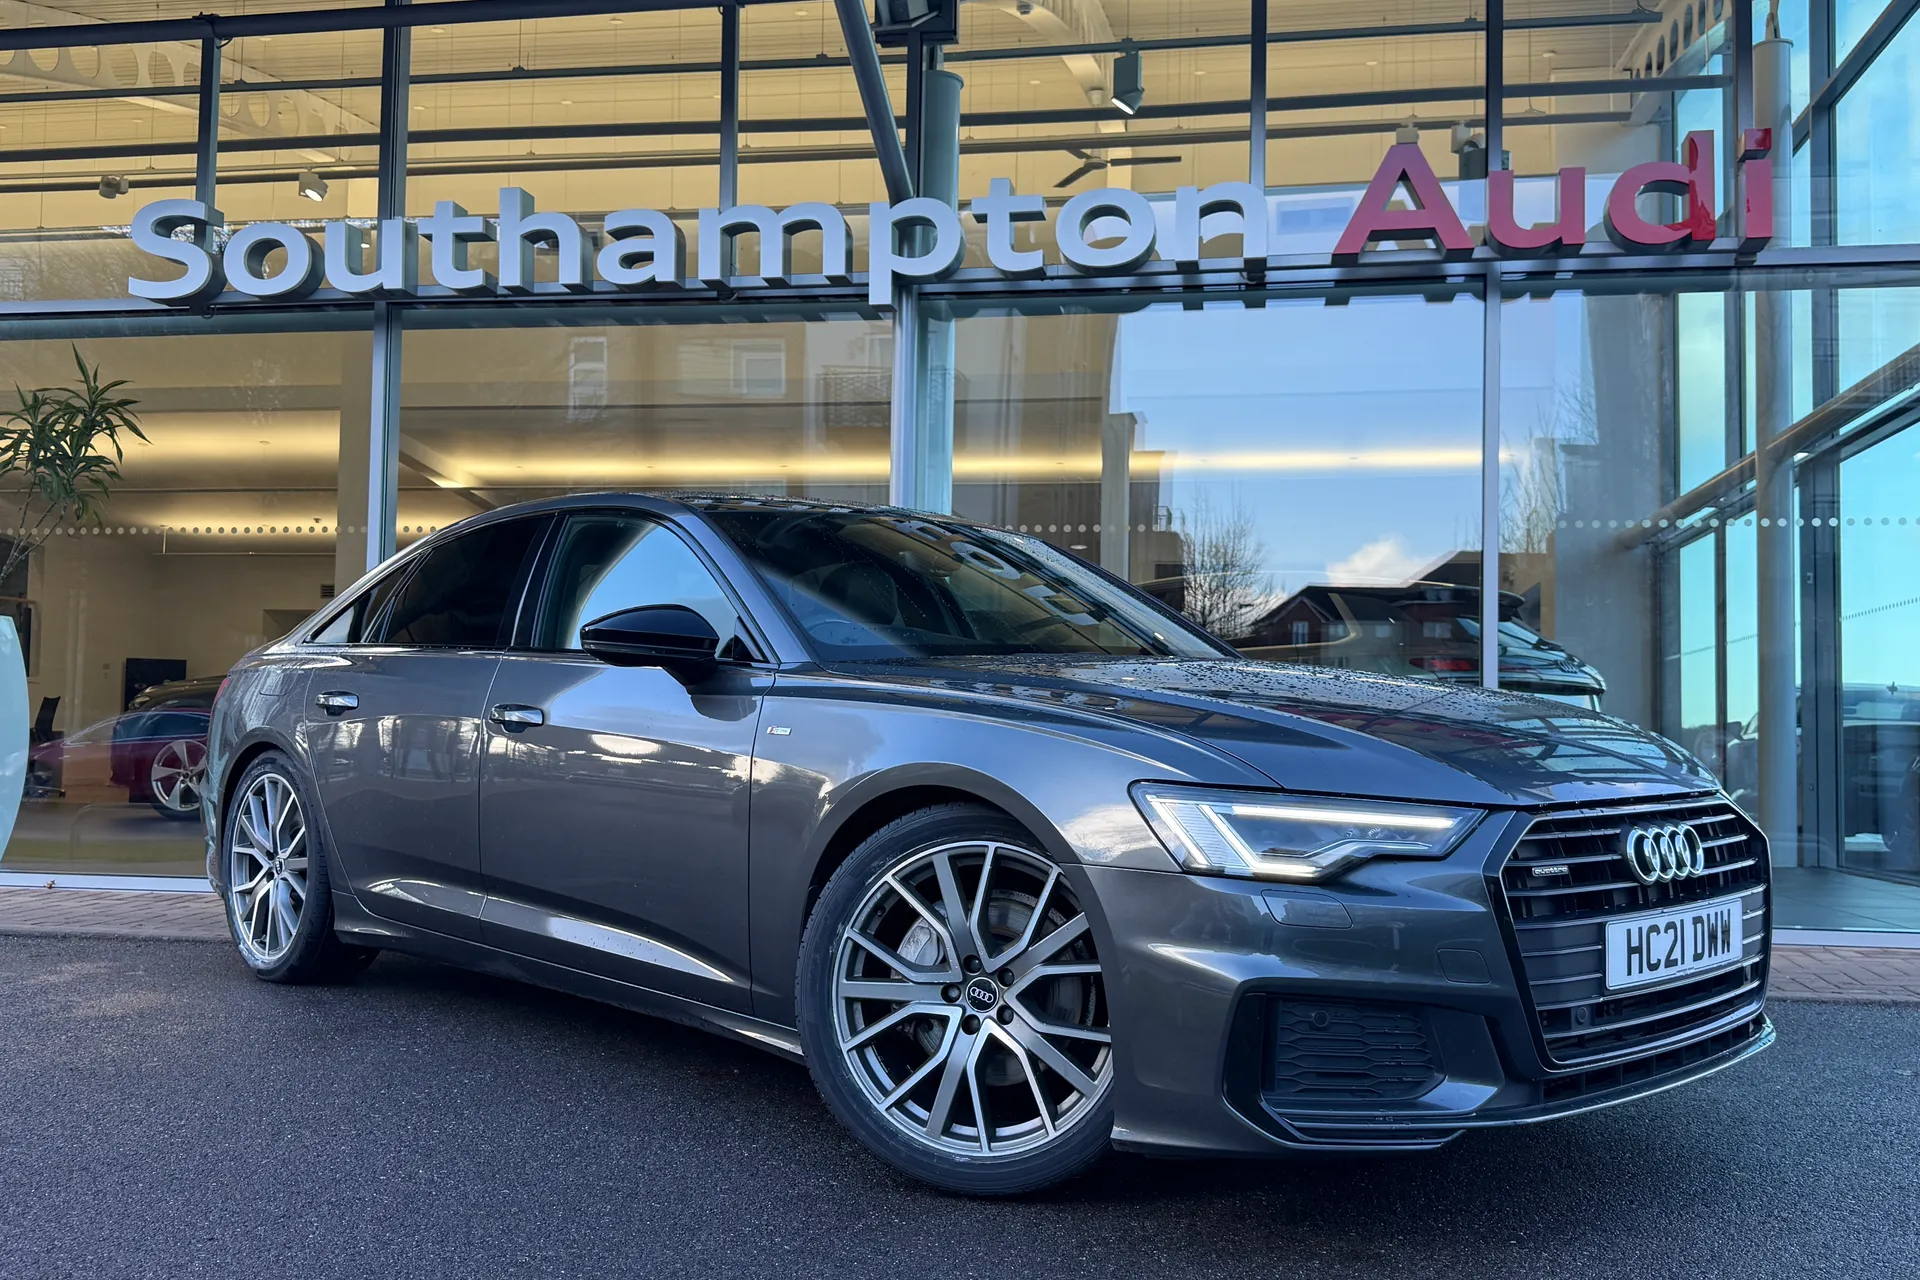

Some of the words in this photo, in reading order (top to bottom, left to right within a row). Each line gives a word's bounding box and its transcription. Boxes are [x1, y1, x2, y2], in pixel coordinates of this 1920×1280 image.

[128, 179, 1268, 306] Southampton
[1332, 128, 1773, 266] Audi
[1626, 918, 1685, 976] HC21
[1692, 908, 1731, 962] DWW
